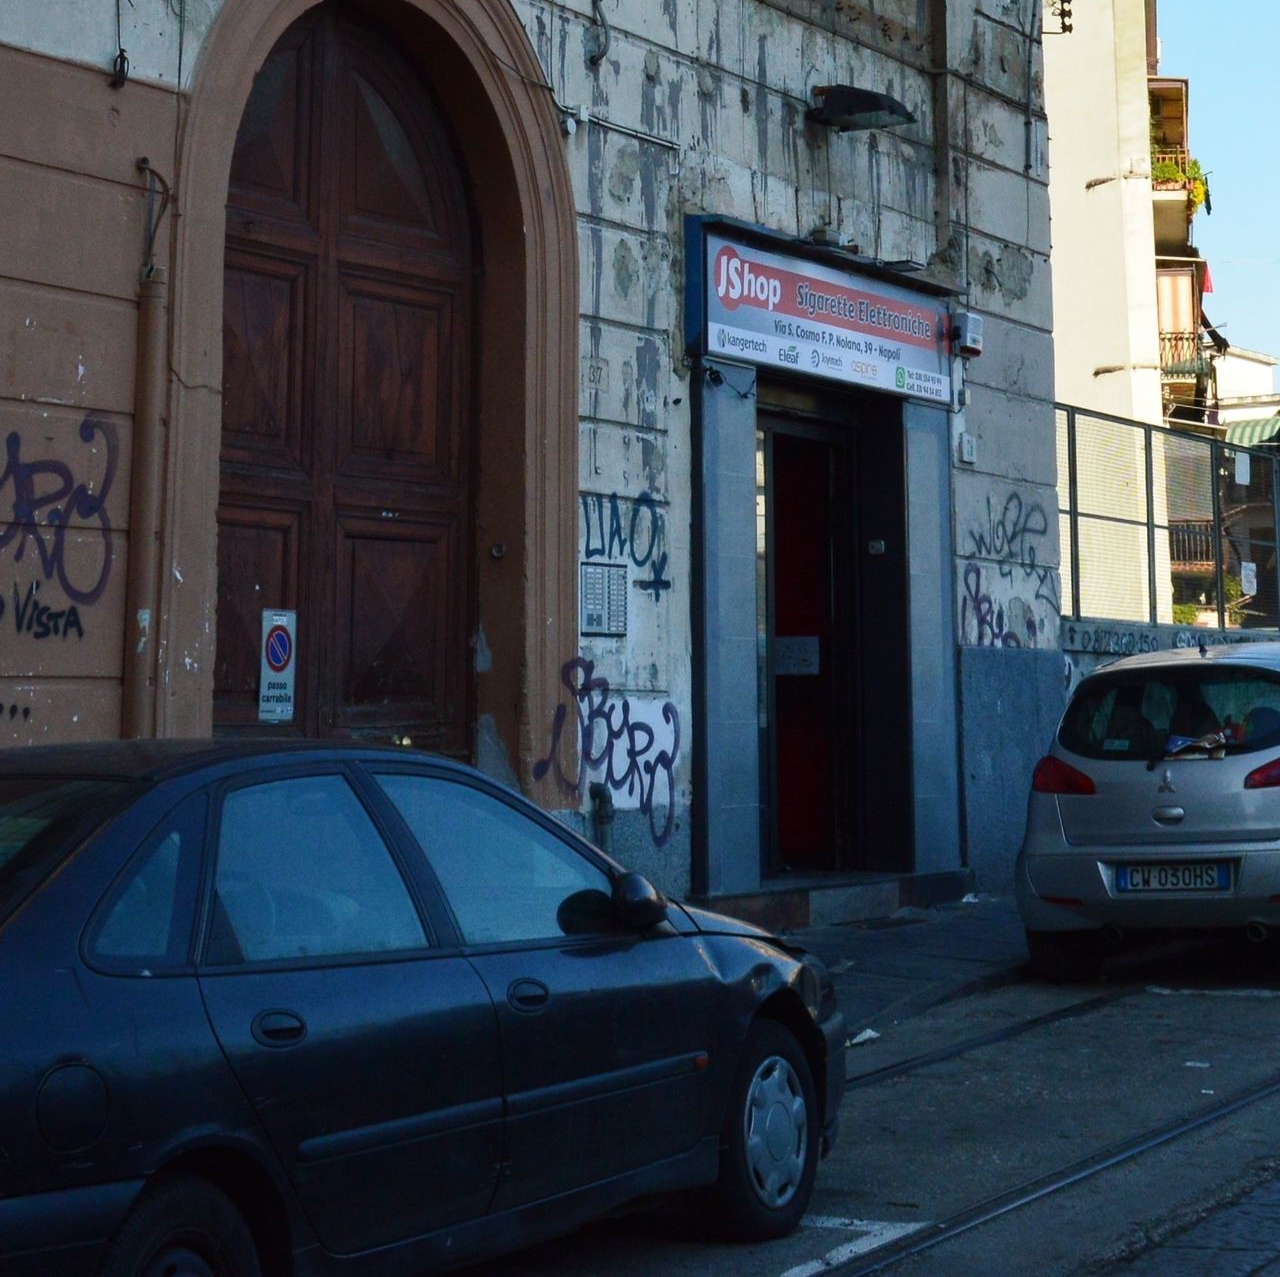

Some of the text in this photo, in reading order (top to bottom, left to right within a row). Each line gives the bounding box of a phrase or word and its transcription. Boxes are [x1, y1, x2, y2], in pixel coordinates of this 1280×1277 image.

[718, 255, 781, 311] JShop
[797, 284, 931, 340] Sigarette Elettroniche
[727, 332, 767, 353] kangertech
[774, 320, 787, 334] Via
[796, 326, 820, 342] Cosmo
[864, 342, 873, 355] 39
[879, 345, 900, 362] Napoli
[779, 348, 799, 364] Eleaf
[589, 364, 603, 384] 37
[267, 682, 287, 691] passo
[261, 694, 292, 704] carrabile
[1129, 866, 1216, 888] CW 030HS
